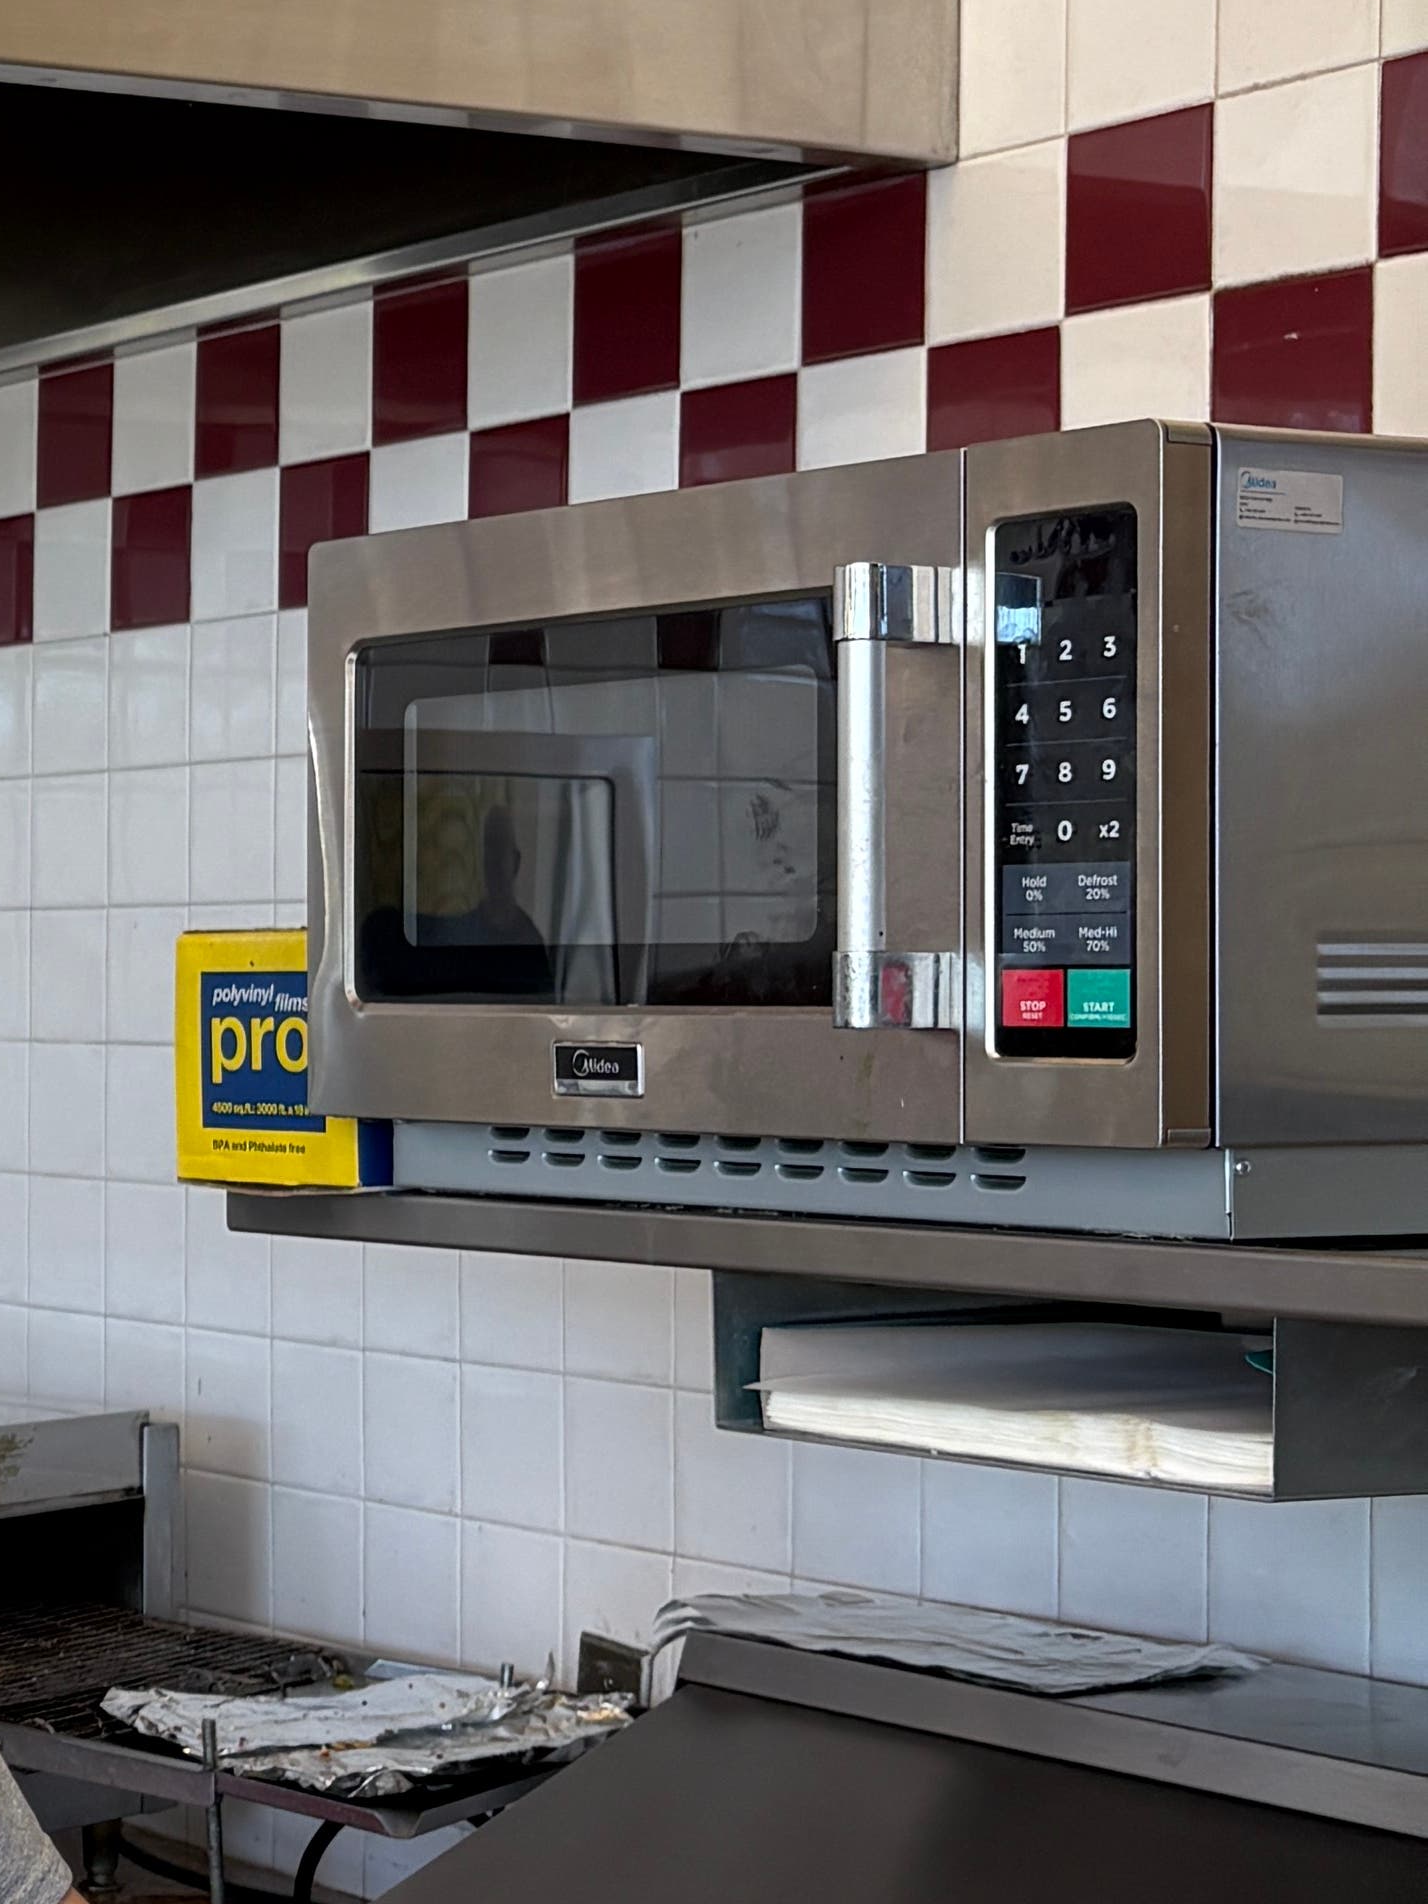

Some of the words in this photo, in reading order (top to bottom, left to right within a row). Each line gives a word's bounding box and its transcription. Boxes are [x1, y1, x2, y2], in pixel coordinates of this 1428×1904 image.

[1022, 877, 1047, 888] Hold
[1078, 875, 1118, 887] Defrost
[1014, 927, 1055, 939] Medium
[1079, 927, 1117, 938] Med-Hi
[212, 984, 274, 1007] polyvinyl
[1020, 1001, 1046, 1012] STOP
[1083, 1002, 1115, 1013] START
[211, 1016, 308, 1084] pro
[572, 1049, 620, 1077] Midea
